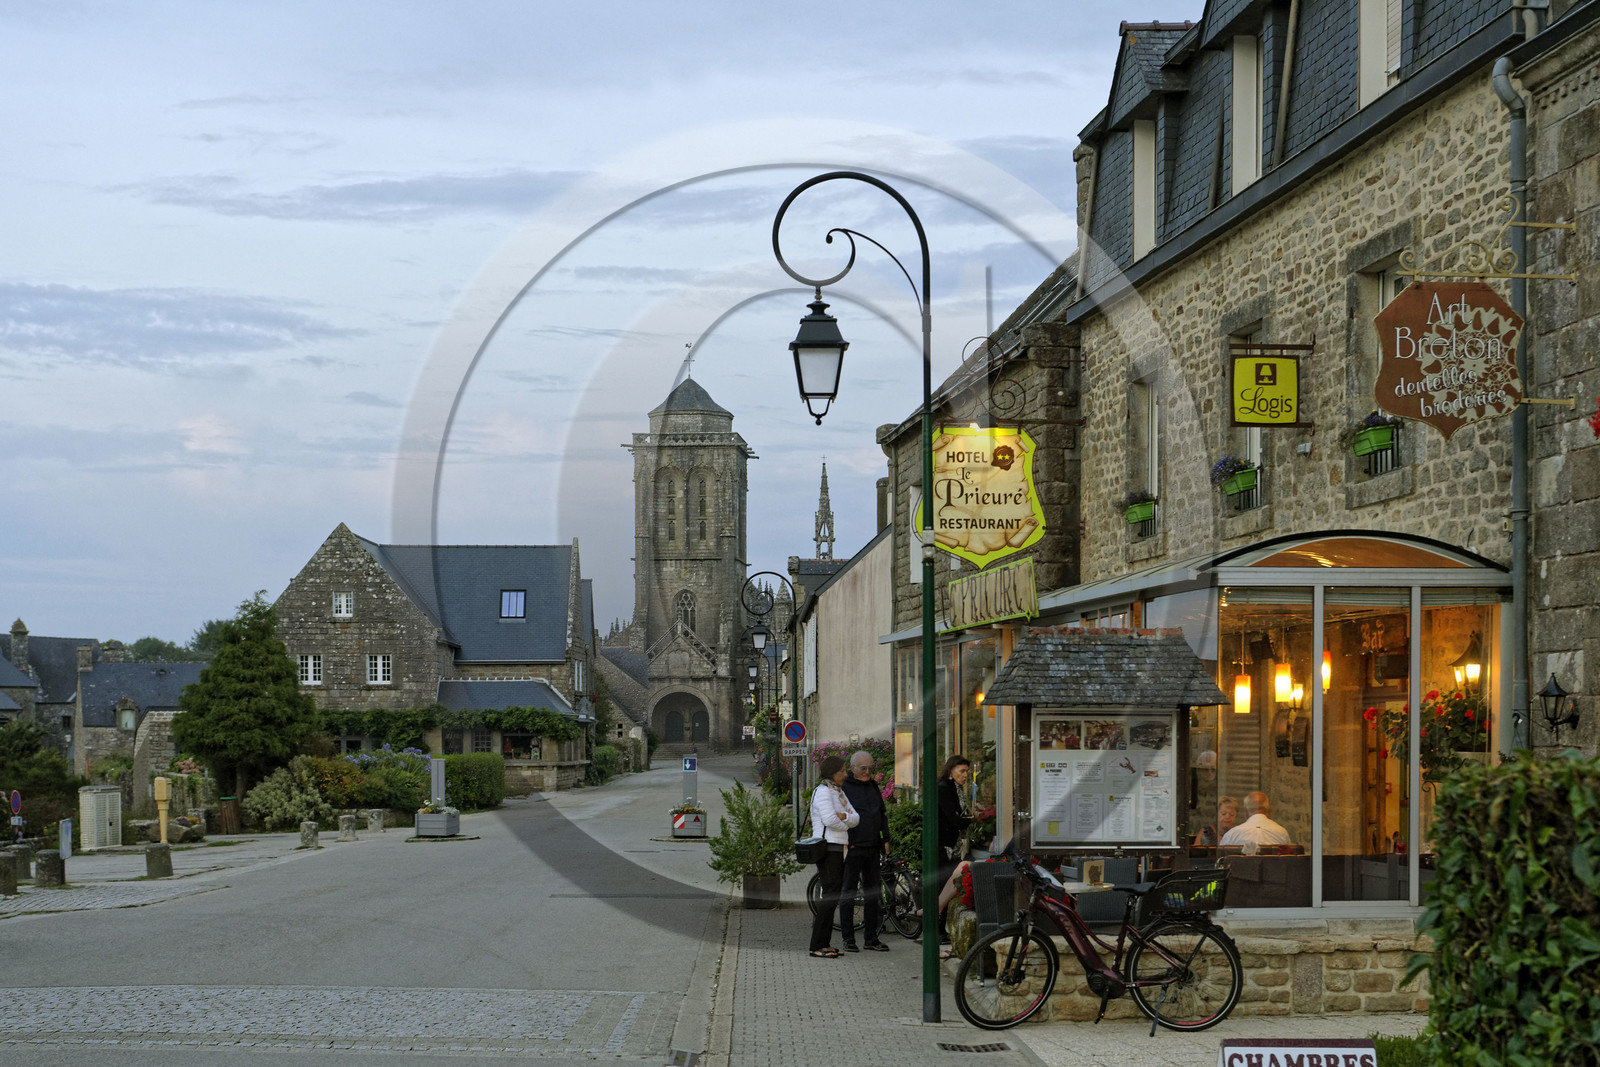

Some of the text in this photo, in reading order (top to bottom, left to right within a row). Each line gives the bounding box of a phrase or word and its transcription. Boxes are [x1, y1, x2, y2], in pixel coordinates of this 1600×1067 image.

[1425, 291, 1473, 325] Art
[1394, 326, 1502, 360] Breton
[1394, 366, 1478, 398] dentelles
[1238, 386, 1293, 419] Logis
[1420, 389, 1507, 418] broderies
[946, 451, 988, 463] HOTEL
[934, 478, 1023, 517] Prieuré
[940, 518, 1021, 530] RESTAURANT
